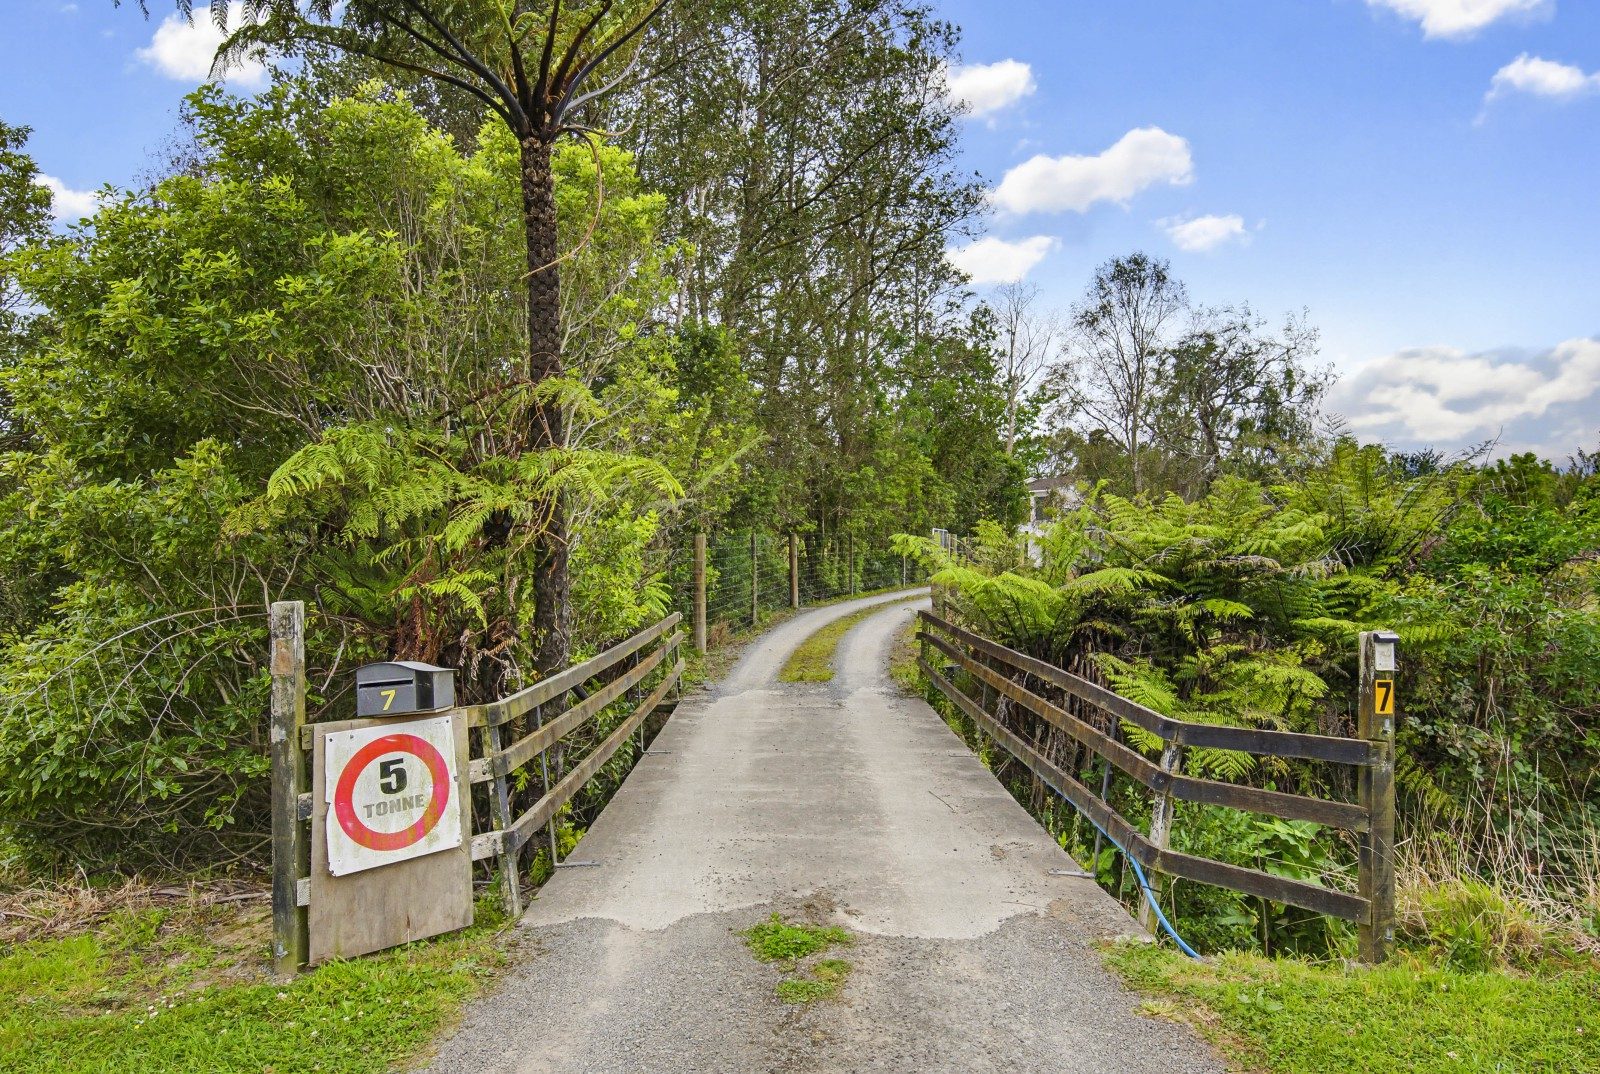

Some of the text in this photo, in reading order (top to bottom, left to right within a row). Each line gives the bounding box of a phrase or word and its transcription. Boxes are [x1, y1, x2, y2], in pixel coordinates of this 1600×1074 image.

[380, 689, 396, 711] 7
[1377, 682, 1392, 711] 7
[379, 758, 408, 795] 5
[363, 794, 425, 819] TONNE
